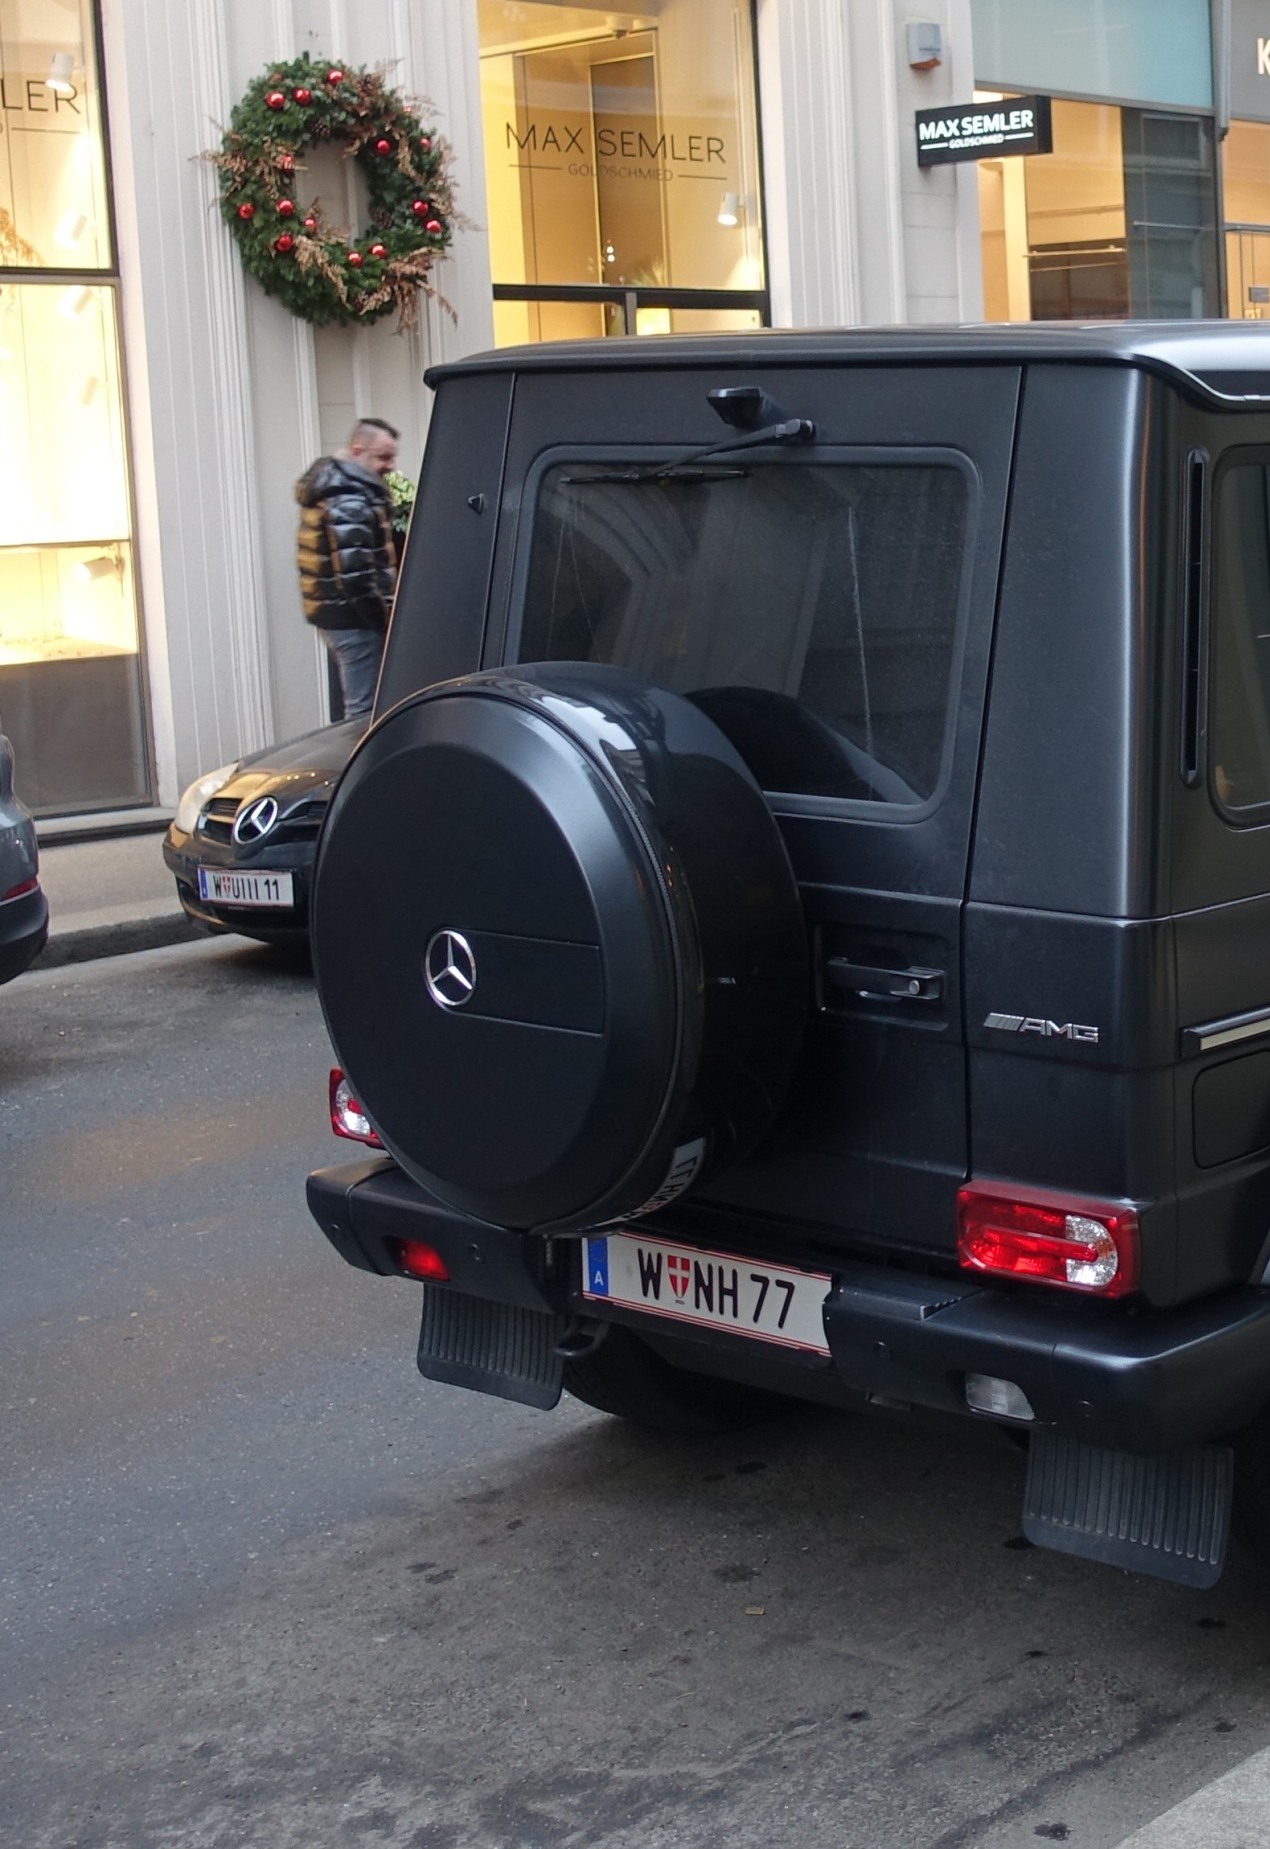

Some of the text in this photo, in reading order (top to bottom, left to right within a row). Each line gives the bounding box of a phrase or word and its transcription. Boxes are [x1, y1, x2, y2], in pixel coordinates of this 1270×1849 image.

[919, 110, 1034, 141] MAX SEMLER
[506, 121, 727, 163] MAX SEMLER
[568, 163, 674, 181] GOLDSCHMIED
[213, 875, 222, 898] W
[264, 878, 279, 900] 11
[1019, 1017, 1099, 1043] AMG
[594, 1270, 604, 1286] A
[637, 1248, 795, 1329] W NH 77
